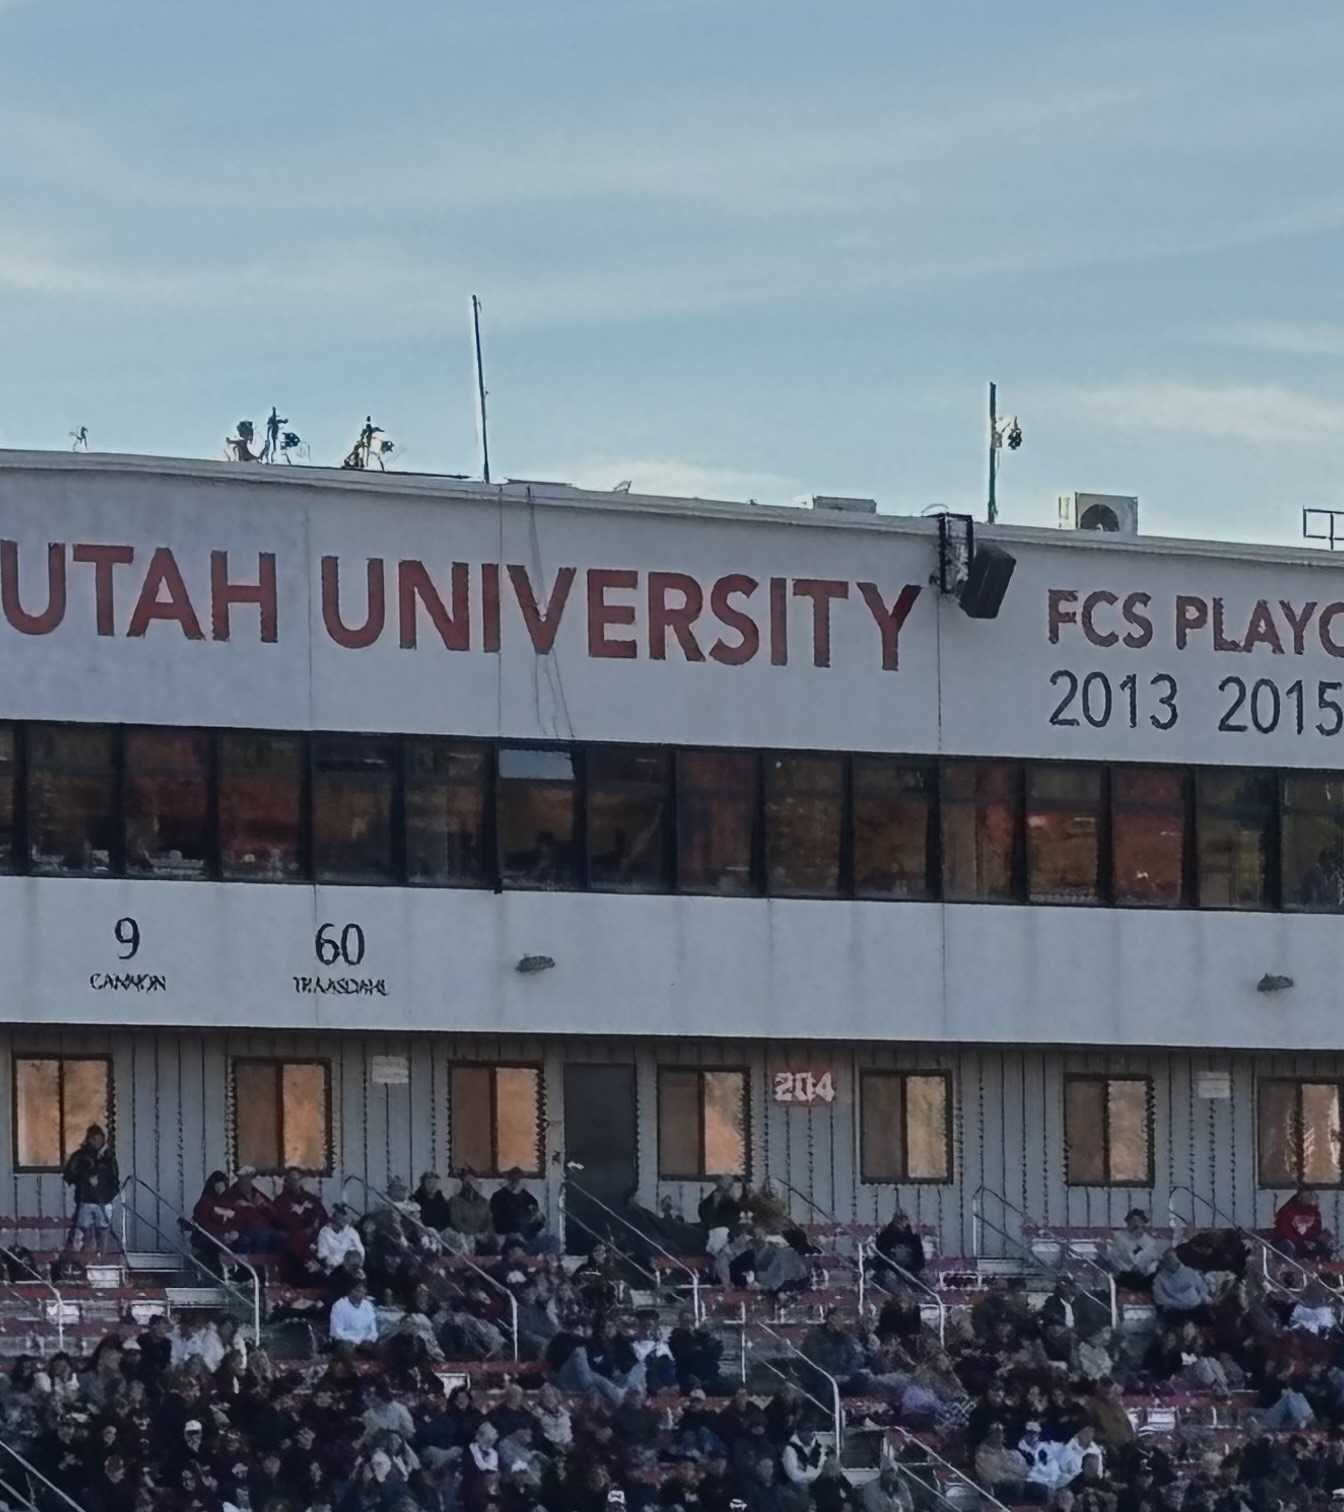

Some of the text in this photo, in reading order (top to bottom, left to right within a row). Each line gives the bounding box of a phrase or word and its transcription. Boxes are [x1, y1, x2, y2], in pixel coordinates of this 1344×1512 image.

[0, 539, 279, 643] UTAH
[321, 555, 923, 671] UNIVERSITY
[1047, 588, 1154, 649] FCS
[1048, 669, 1179, 731] 2013
[1217, 676, 1344, 737] 2015
[114, 916, 141, 960] 9
[315, 922, 366, 966] 60
[774, 1072, 835, 1103] 204
